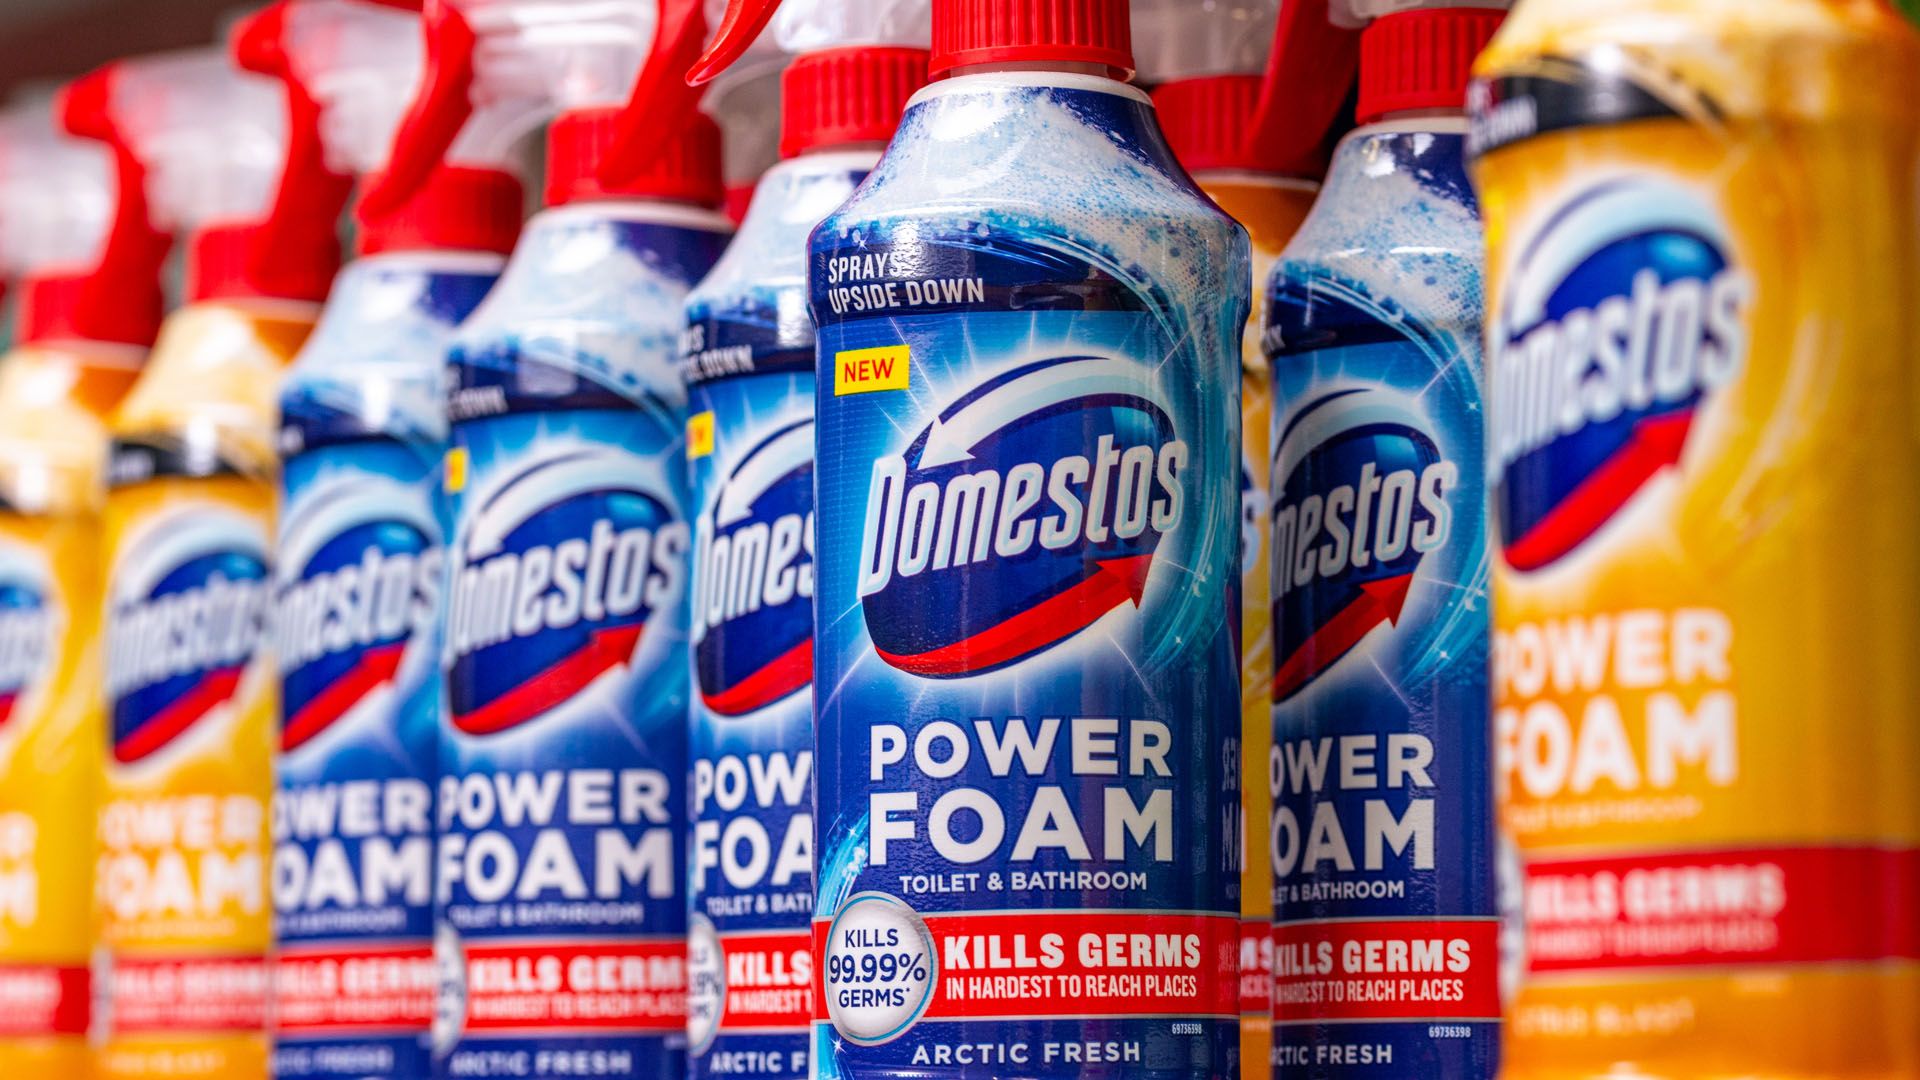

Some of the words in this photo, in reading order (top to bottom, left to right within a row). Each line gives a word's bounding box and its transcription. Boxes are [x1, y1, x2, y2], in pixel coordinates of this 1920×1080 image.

[829, 253, 903, 284] SPRAYS
[829, 282, 900, 314] UPSIDE
[906, 278, 984, 306] DOWN
[844, 357, 894, 383] NEW
[857, 434, 1188, 598] Domestos
[870, 718, 1172, 781] POWER
[1270, 733, 1435, 798] OWER
[439, 769, 671, 831] POWER
[869, 785, 1173, 866] FOAM
[1270, 799, 1435, 877] OAM
[436, 828, 674, 903] FOAM
[899, 873, 979, 894] TOILET
[987, 872, 1004, 891] &
[1011, 871, 1147, 891] BATHROOM
[1302, 880, 1405, 900] BATHROOM
[705, 894, 753, 917] TOILET
[755, 893, 767, 914] &
[845, 928, 899, 949] KILLS
[944, 933, 1065, 970] KILLS
[1078, 932, 1201, 969] GERMS
[566, 954, 687, 992] GERM
[727, 950, 812, 987] KILLS
[829, 952, 926, 984] 99.99%
[1273, 940, 1334, 978] KILLS
[1342, 938, 1471, 974] GERMS
[946, 977, 963, 1000] IN
[969, 975, 1053, 999] HARDEST
[1057, 975, 1081, 999] TO
[1087, 974, 1141, 998] REACH
[1145, 974, 1197, 998] PLACES
[1327, 980, 1344, 1002] TO
[1347, 979, 1395, 1002] REACH
[1400, 978, 1464, 1001] PLACES
[1172, 1023, 1202, 1036] 69736398
[1428, 1025, 1471, 1039] 69736398
[709, 1051, 783, 1074] ARCTIC
[911, 1043, 1029, 1065] ARCTIC
[1044, 1041, 1140, 1063] FRESH
[1316, 1044, 1392, 1065] FRESH
